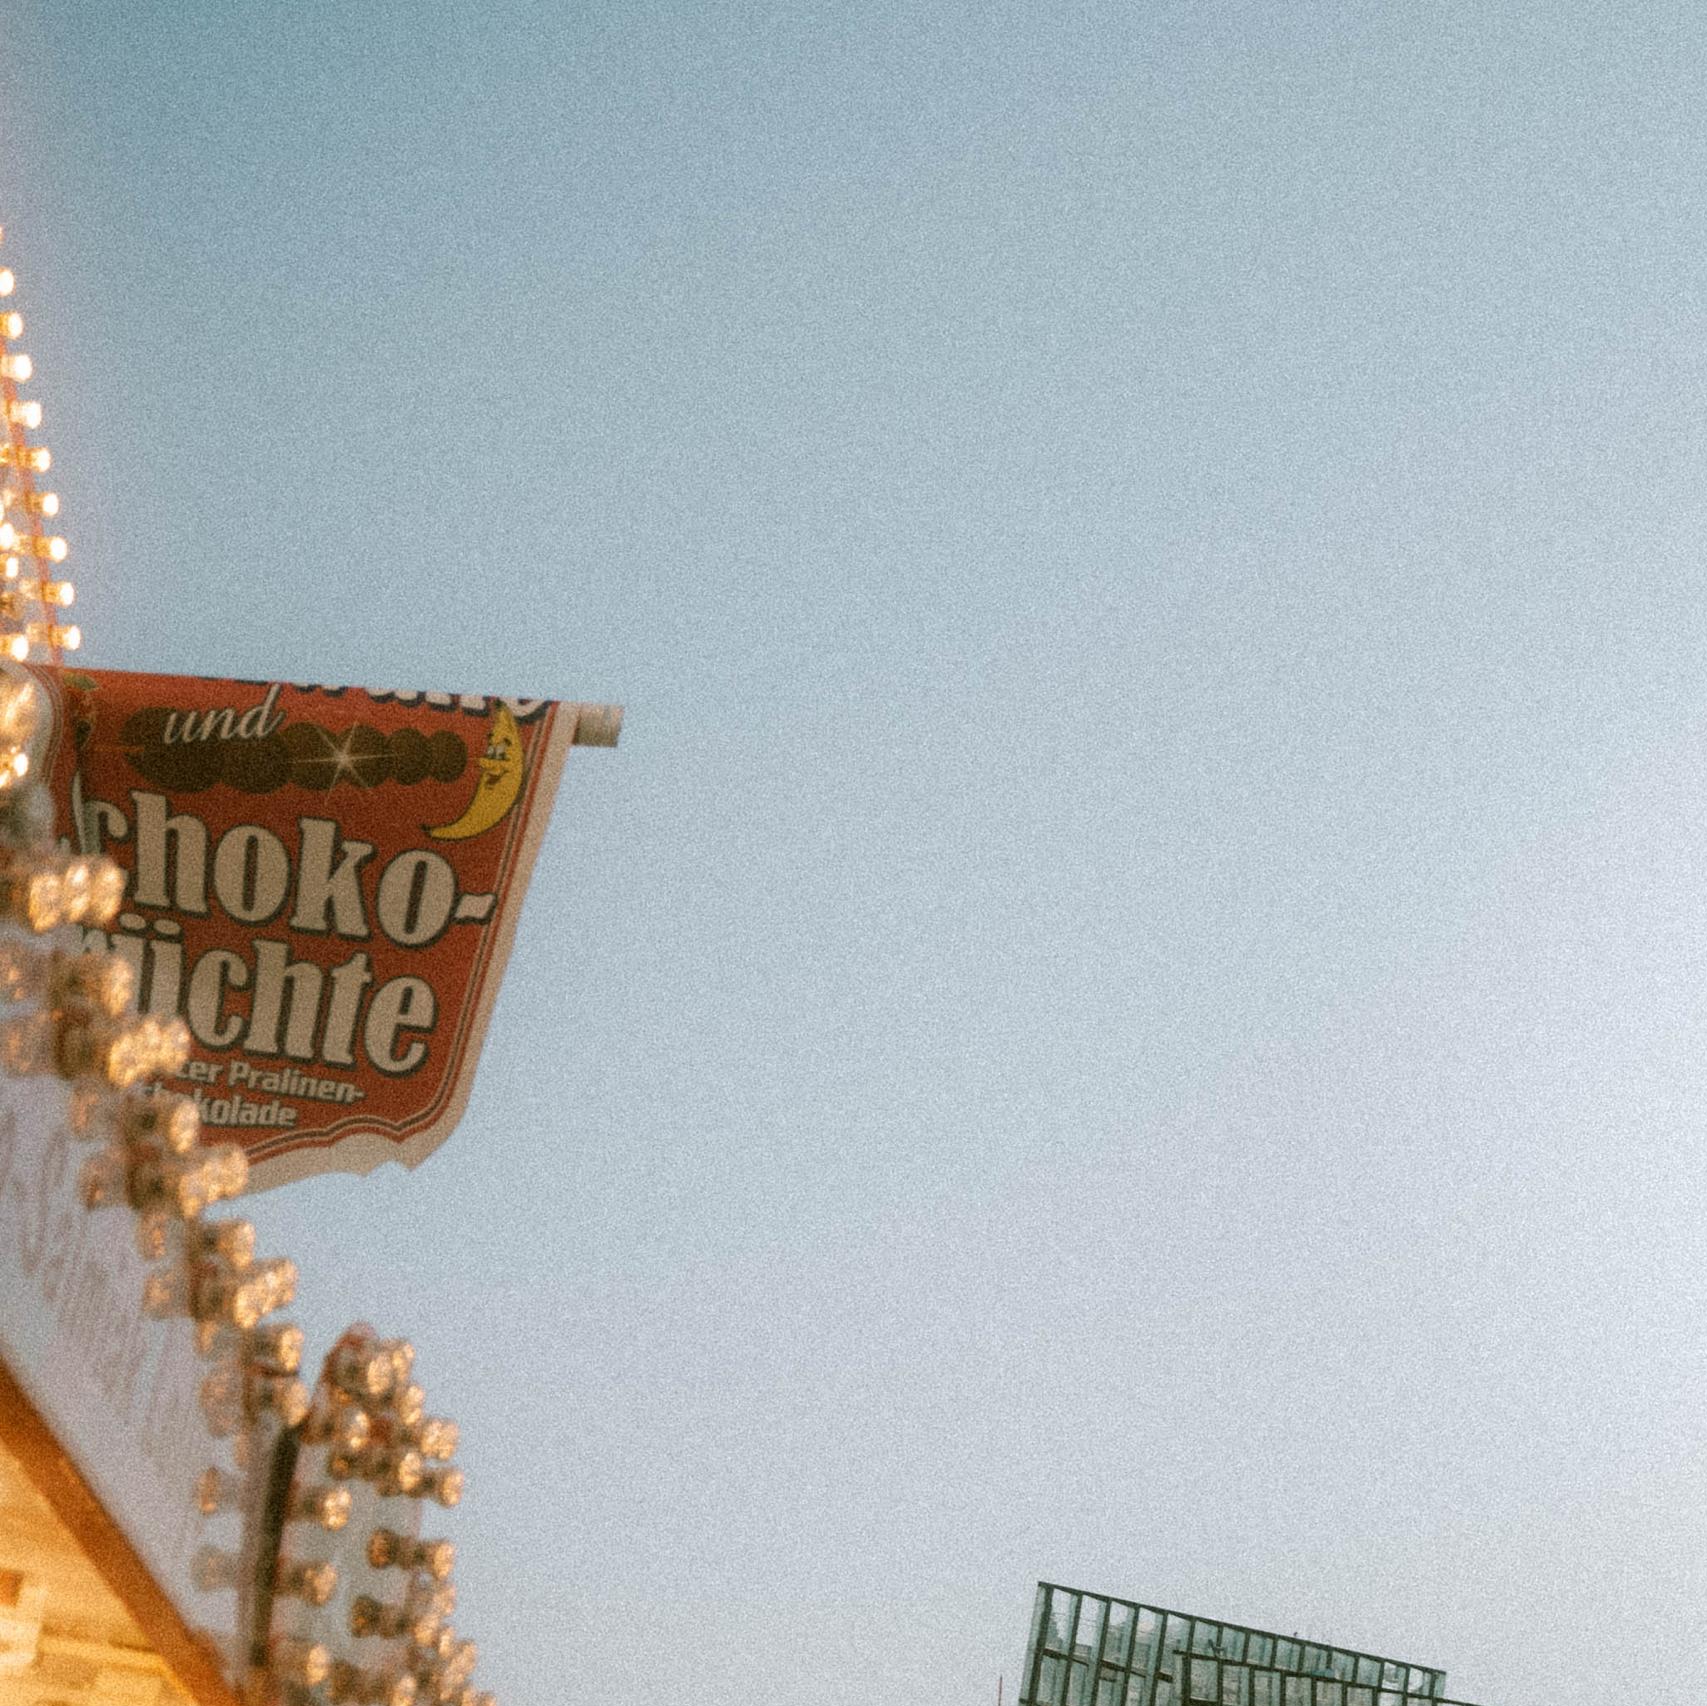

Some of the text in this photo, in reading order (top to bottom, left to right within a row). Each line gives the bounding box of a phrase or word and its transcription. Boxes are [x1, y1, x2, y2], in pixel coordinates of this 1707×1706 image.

[163, 684, 287, 745] und
[85, 790, 498, 947] choko-
[82, 913, 437, 1076] üchte
[228, 1061, 365, 1103] Pralinen-
